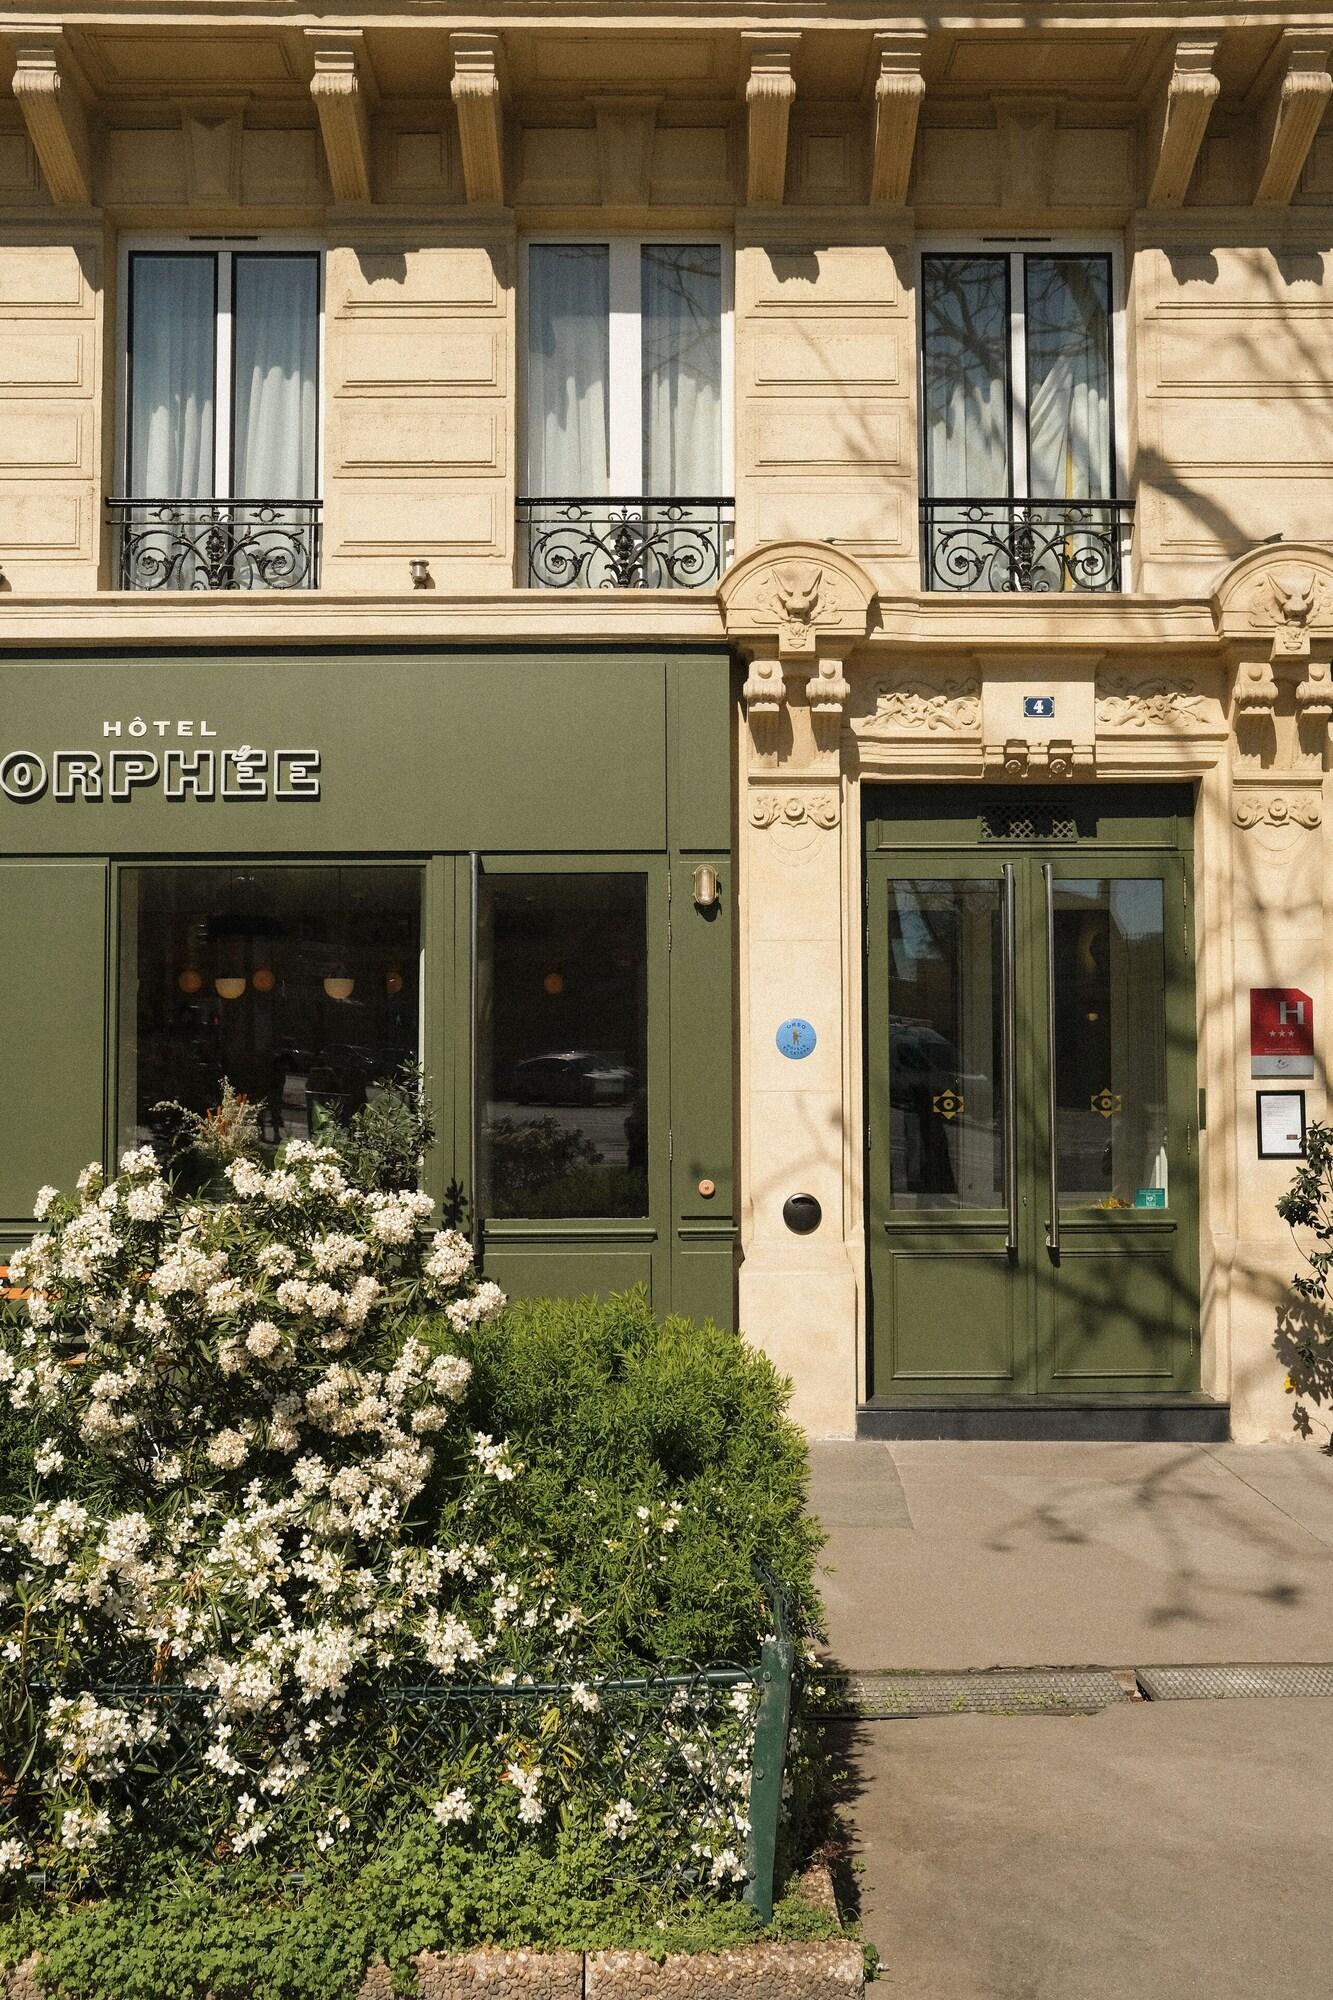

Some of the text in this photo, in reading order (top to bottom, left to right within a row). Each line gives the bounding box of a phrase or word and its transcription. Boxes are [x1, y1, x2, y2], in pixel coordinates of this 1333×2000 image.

[1033, 699, 1044, 714] 4
[103, 716, 217, 737] HÔTEL
[0, 745, 320, 797] ORPHÉE
[1279, 1000, 1306, 1025] H
